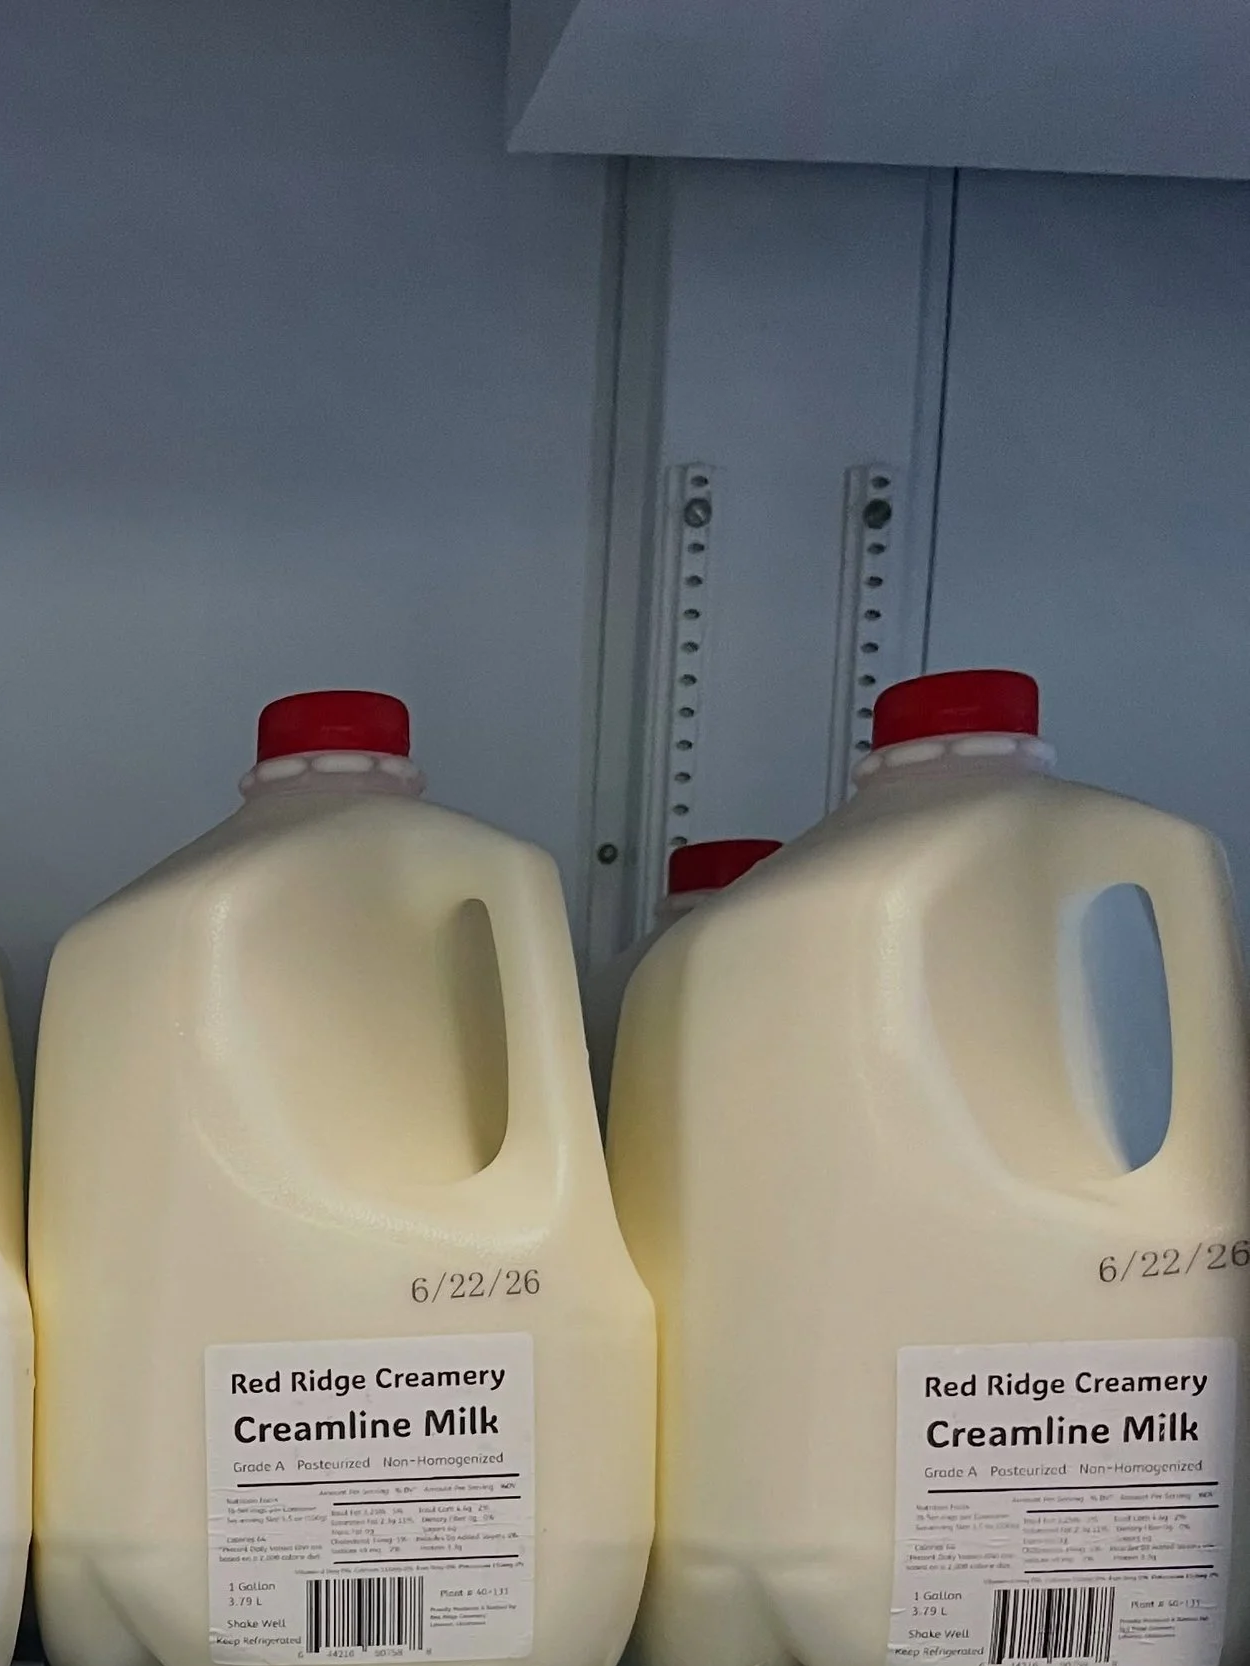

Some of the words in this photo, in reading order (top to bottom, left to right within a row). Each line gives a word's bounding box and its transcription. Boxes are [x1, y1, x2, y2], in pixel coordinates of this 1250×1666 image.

[1099, 1240, 1250, 1283] 6/22/26
[411, 1269, 540, 1303] 6/22/26
[231, 1372, 280, 1394] Red
[291, 1370, 366, 1396] Ridge
[376, 1367, 505, 1390] Creamery
[925, 1375, 976, 1398] Red
[988, 1373, 1065, 1401] Ridge
[1075, 1371, 1207, 1396] Creamery
[235, 1410, 411, 1443] Creamline
[425, 1406, 499, 1437] Milk
[927, 1416, 1109, 1448] Creamline
[1124, 1412, 1199, 1442] Milk
[234, 1461, 271, 1472] Grade
[275, 1461, 284, 1471] A
[297, 1457, 370, 1470] Pasteurized
[383, 1452, 504, 1467] Non-Homogenized
[925, 1466, 965, 1479] Grade
[968, 1466, 977, 1477] A
[991, 1464, 1066, 1477] Pasteurized
[1079, 1460, 1202, 1476] Non-Homogenized
[238, 1581, 275, 1591] Gallon
[924, 1590, 962, 1600] Gallon
[912, 1606, 937, 1616] 3.79
[227, 1619, 258, 1629] Shake
[262, 1618, 286, 1628] Well
[216, 1636, 240, 1647] Keep
[244, 1635, 301, 1647] Refrigerated
[909, 1629, 941, 1639] Shake
[944, 1629, 969, 1639] Well
[895, 1647, 920, 1658] Keep
[924, 1646, 984, 1658] Refrigerated
